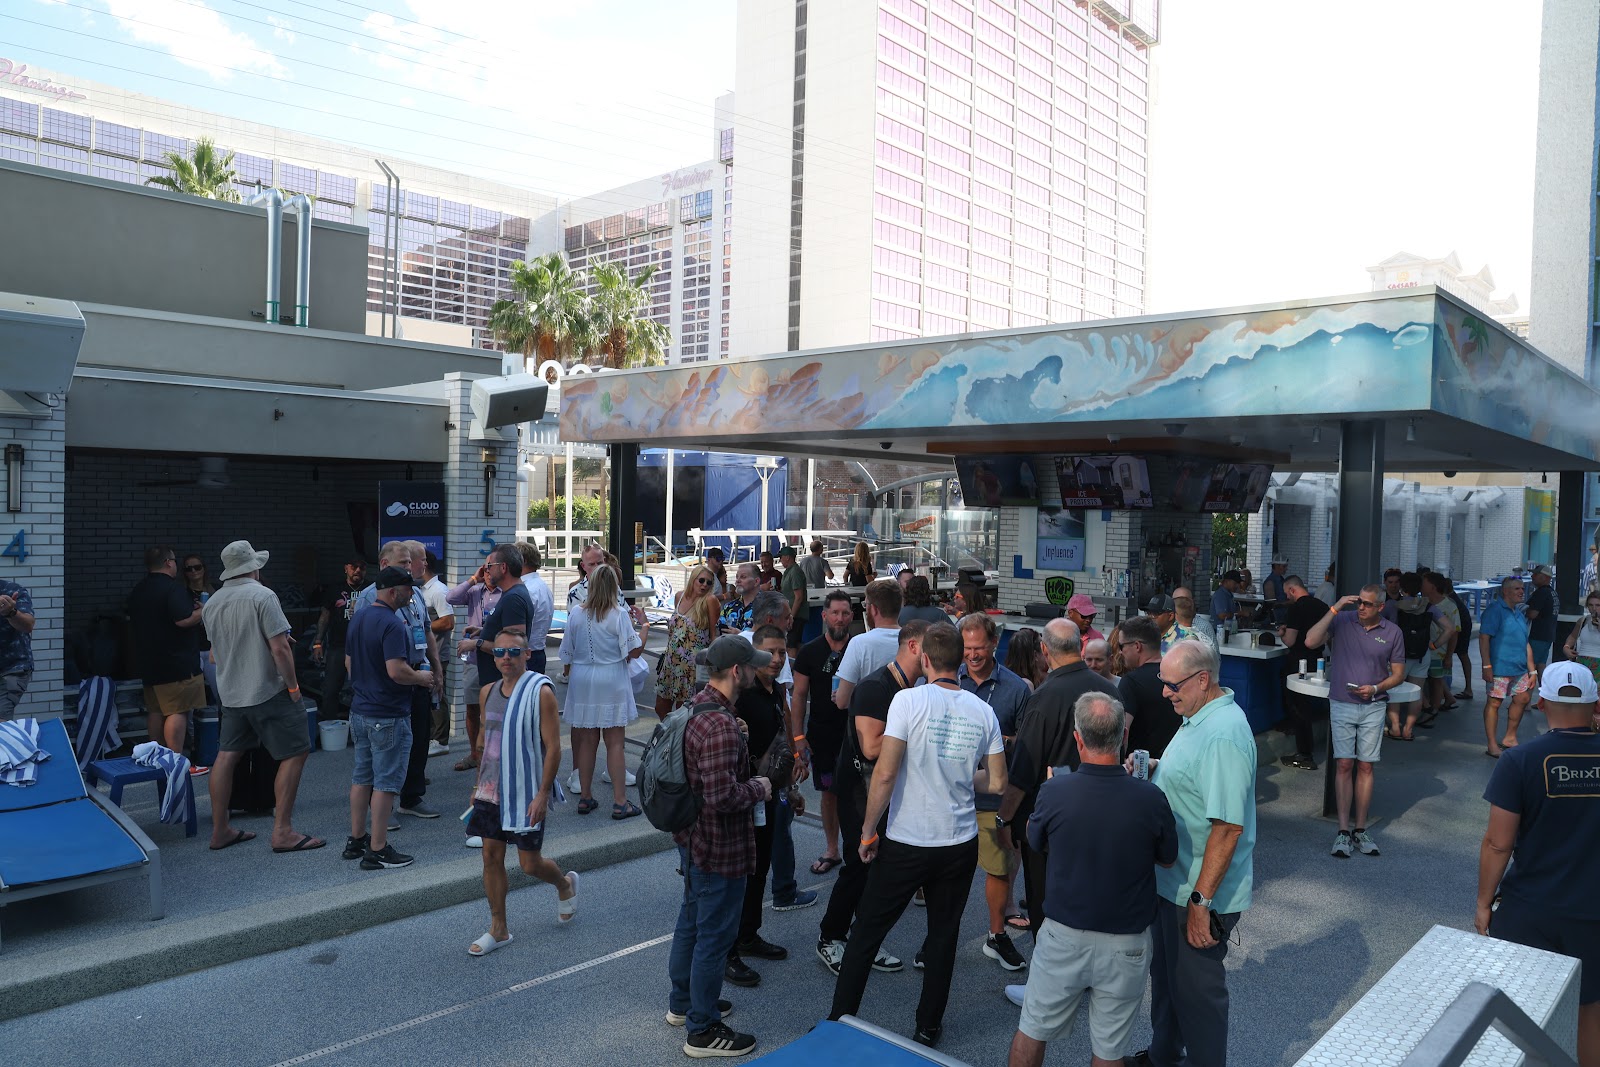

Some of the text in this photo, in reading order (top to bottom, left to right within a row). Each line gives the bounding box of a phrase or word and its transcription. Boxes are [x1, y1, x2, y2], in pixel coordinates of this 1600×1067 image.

[1387, 281, 1418, 290] CAESARS
[409, 502, 440, 510] CLOUD
[2, 528, 29, 563] 4
[480, 530, 495, 556] 5
[1047, 580, 1071, 595] HOP
